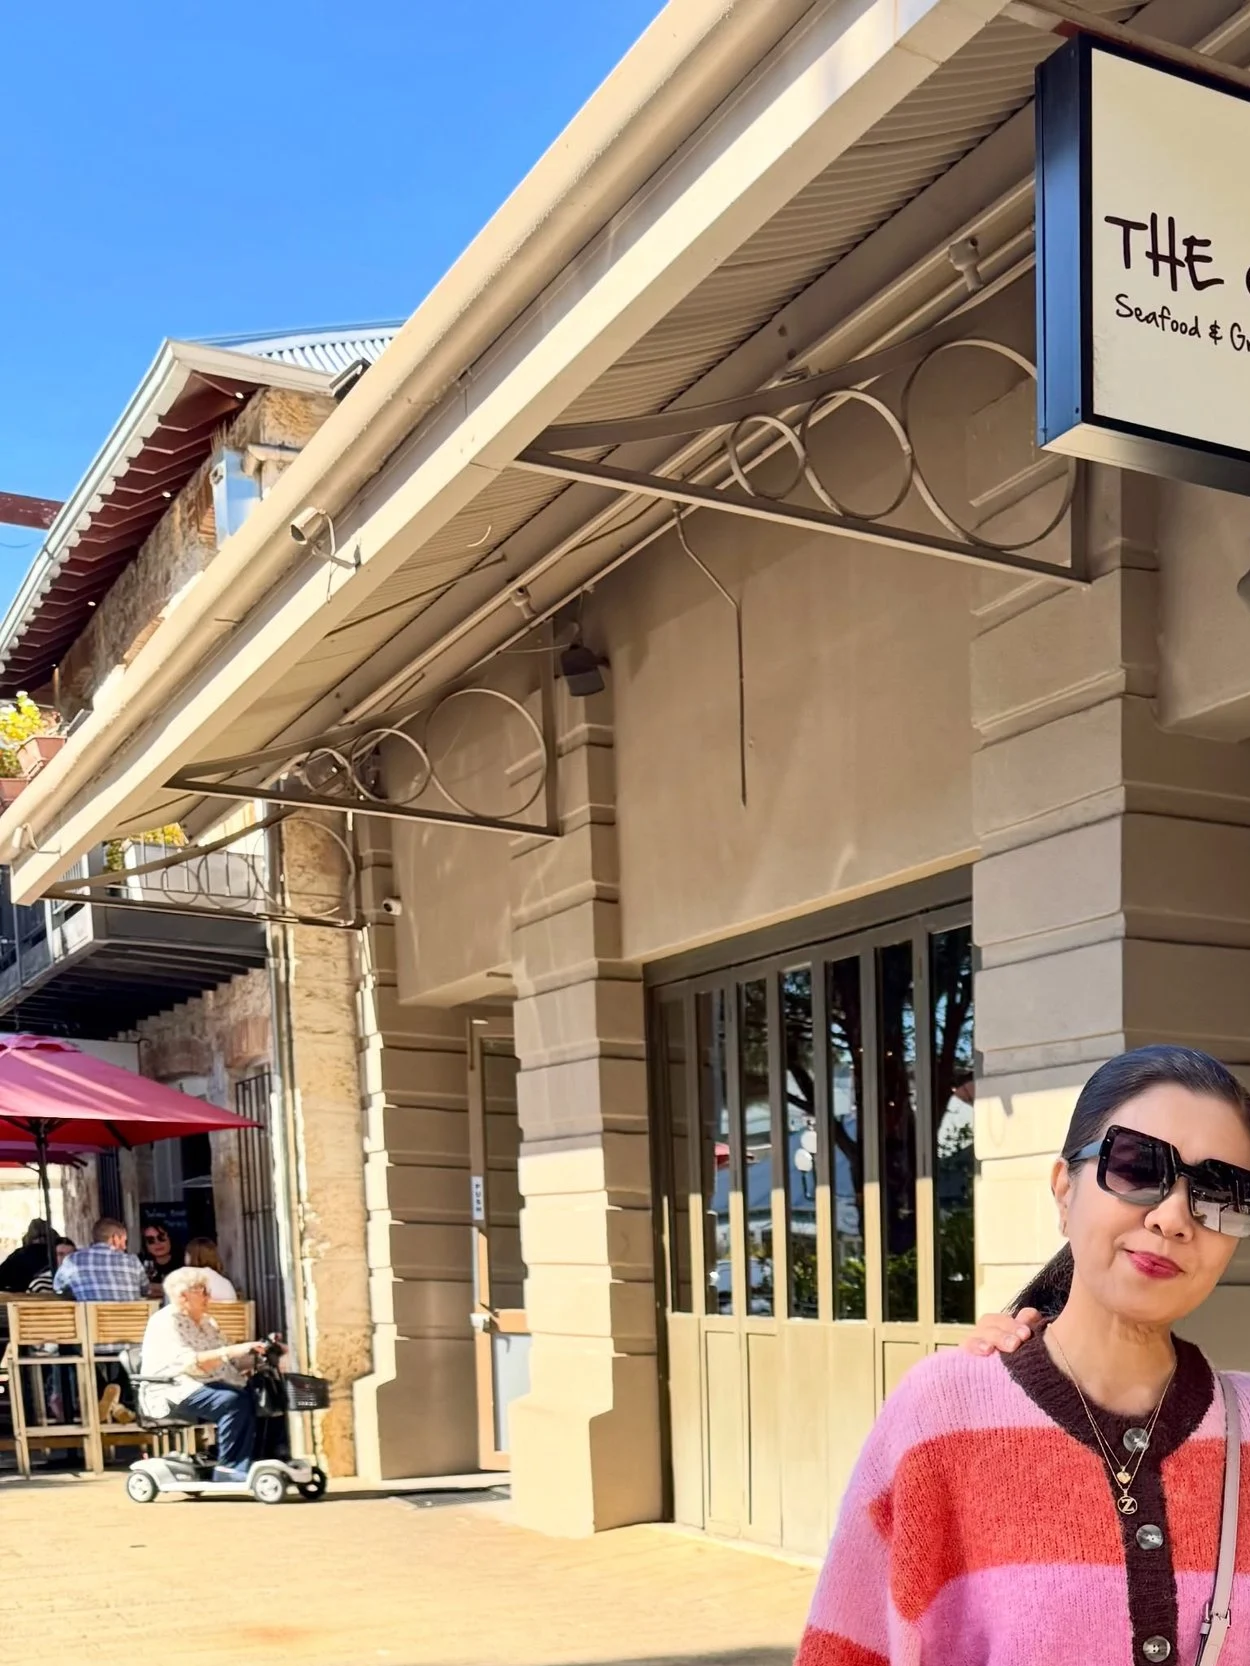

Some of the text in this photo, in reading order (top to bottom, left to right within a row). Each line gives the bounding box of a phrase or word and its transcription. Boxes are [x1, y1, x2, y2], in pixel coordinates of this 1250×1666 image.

[1104, 211, 1225, 292] THE
[1114, 293, 1202, 339] Seafood
[1208, 319, 1223, 346] &
